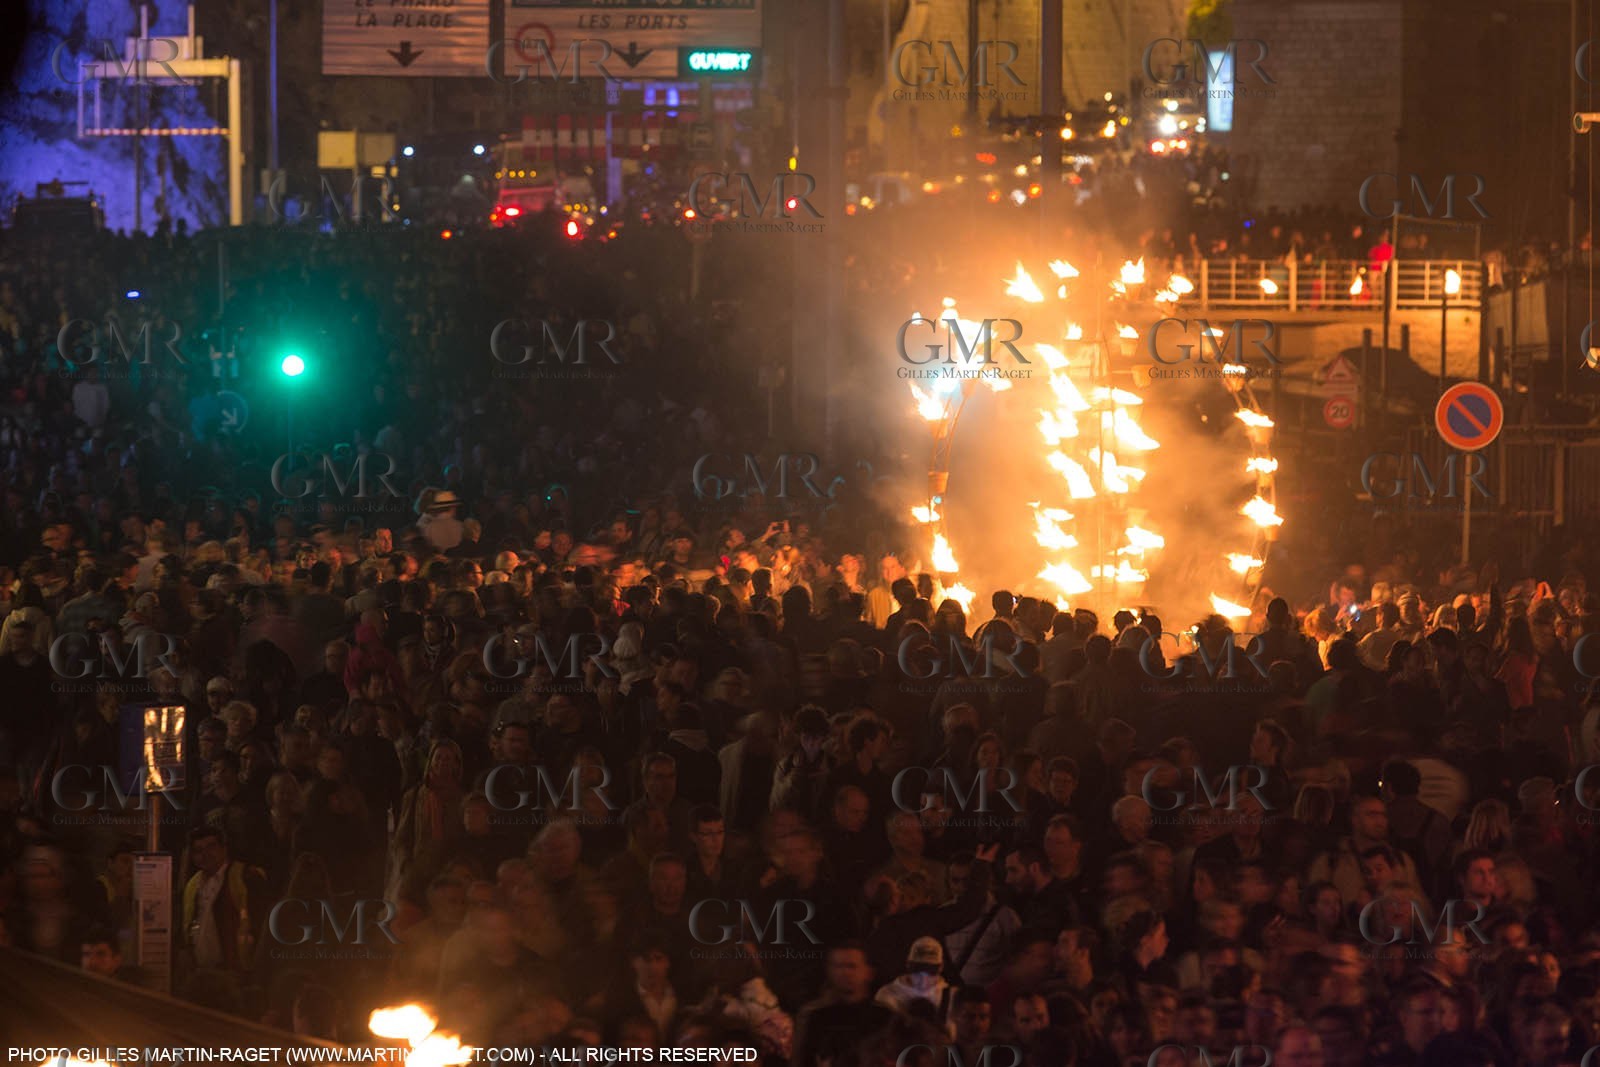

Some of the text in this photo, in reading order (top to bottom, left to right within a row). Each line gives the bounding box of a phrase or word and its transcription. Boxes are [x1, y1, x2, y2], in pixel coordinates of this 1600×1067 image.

[354, 13, 455, 28] LA PLAGE
[577, 14, 689, 30] LES PORTS
[688, 51, 752, 71] OUVERT
[1331, 405, 1350, 419] 20
